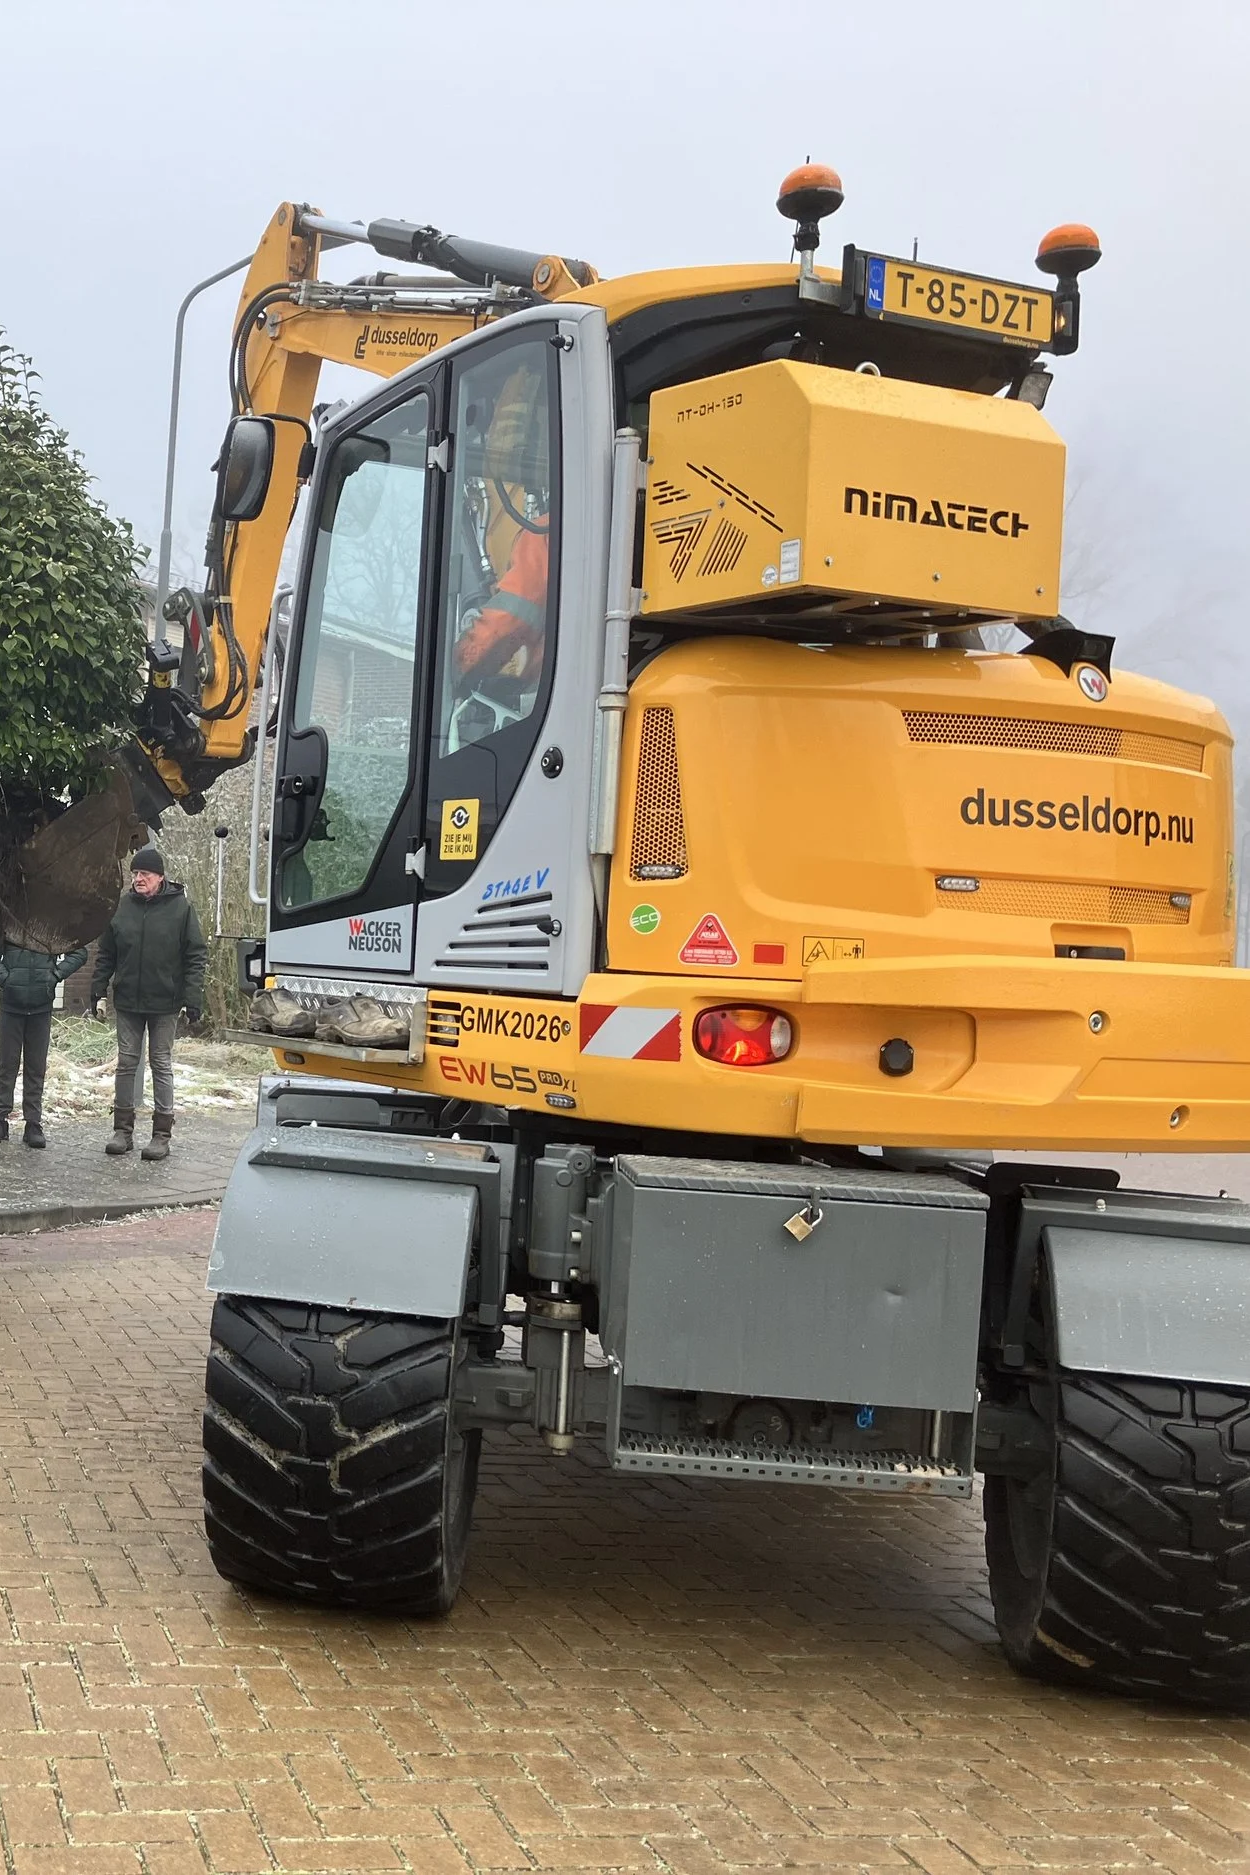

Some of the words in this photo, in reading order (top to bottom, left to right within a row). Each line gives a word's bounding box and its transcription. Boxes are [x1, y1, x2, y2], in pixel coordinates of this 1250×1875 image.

[868, 288, 882, 302] NL
[897, 271, 1039, 332] T-85-DZT
[371, 325, 438, 351] dusseldorp
[960, 788, 1194, 846] dusseldorp.nu
[444, 834, 454, 843] ZIE
[455, 834, 461, 844] JE
[444, 845, 453, 853] ZIE
[455, 845, 461, 853] IK
[462, 845, 473, 855] JOU
[482, 875, 531, 900] STAGE
[537, 868, 549, 889] V
[349, 919, 401, 937] WACKER
[631, 912, 659, 927] ECO
[349, 936, 401, 953] NEUSON
[461, 1006, 561, 1042] GMK2026
[539, 1072, 560, 1085] PRO
